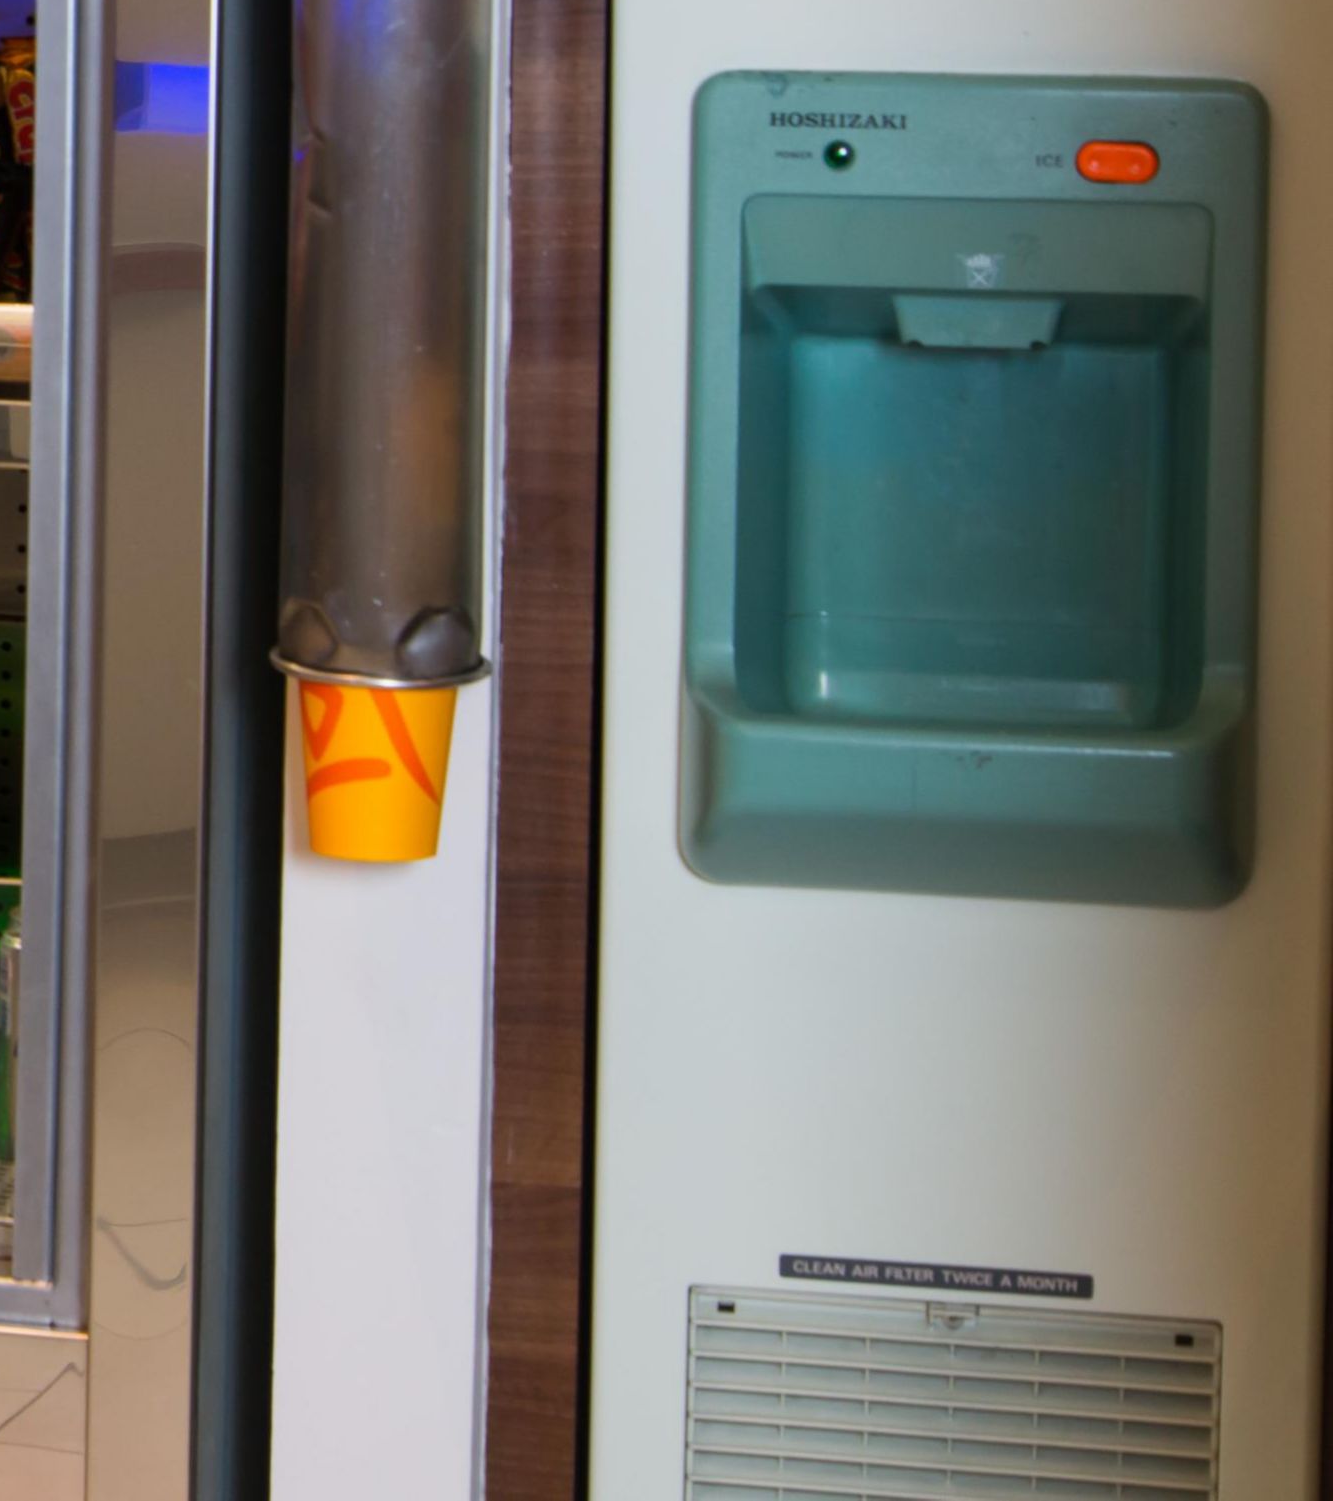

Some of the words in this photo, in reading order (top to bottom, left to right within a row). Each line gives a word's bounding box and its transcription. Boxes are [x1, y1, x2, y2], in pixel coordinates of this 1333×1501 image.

[770, 112, 907, 130] HOSHIZAKI
[1035, 154, 1064, 168] ICE
[792, 1260, 846, 1276] CLEAN
[851, 1264, 879, 1279] AIR
[885, 1266, 933, 1282] FILTER
[942, 1269, 994, 1287] TWICE
[999, 1274, 1012, 1288] A
[1016, 1275, 1078, 1293] MONTH
